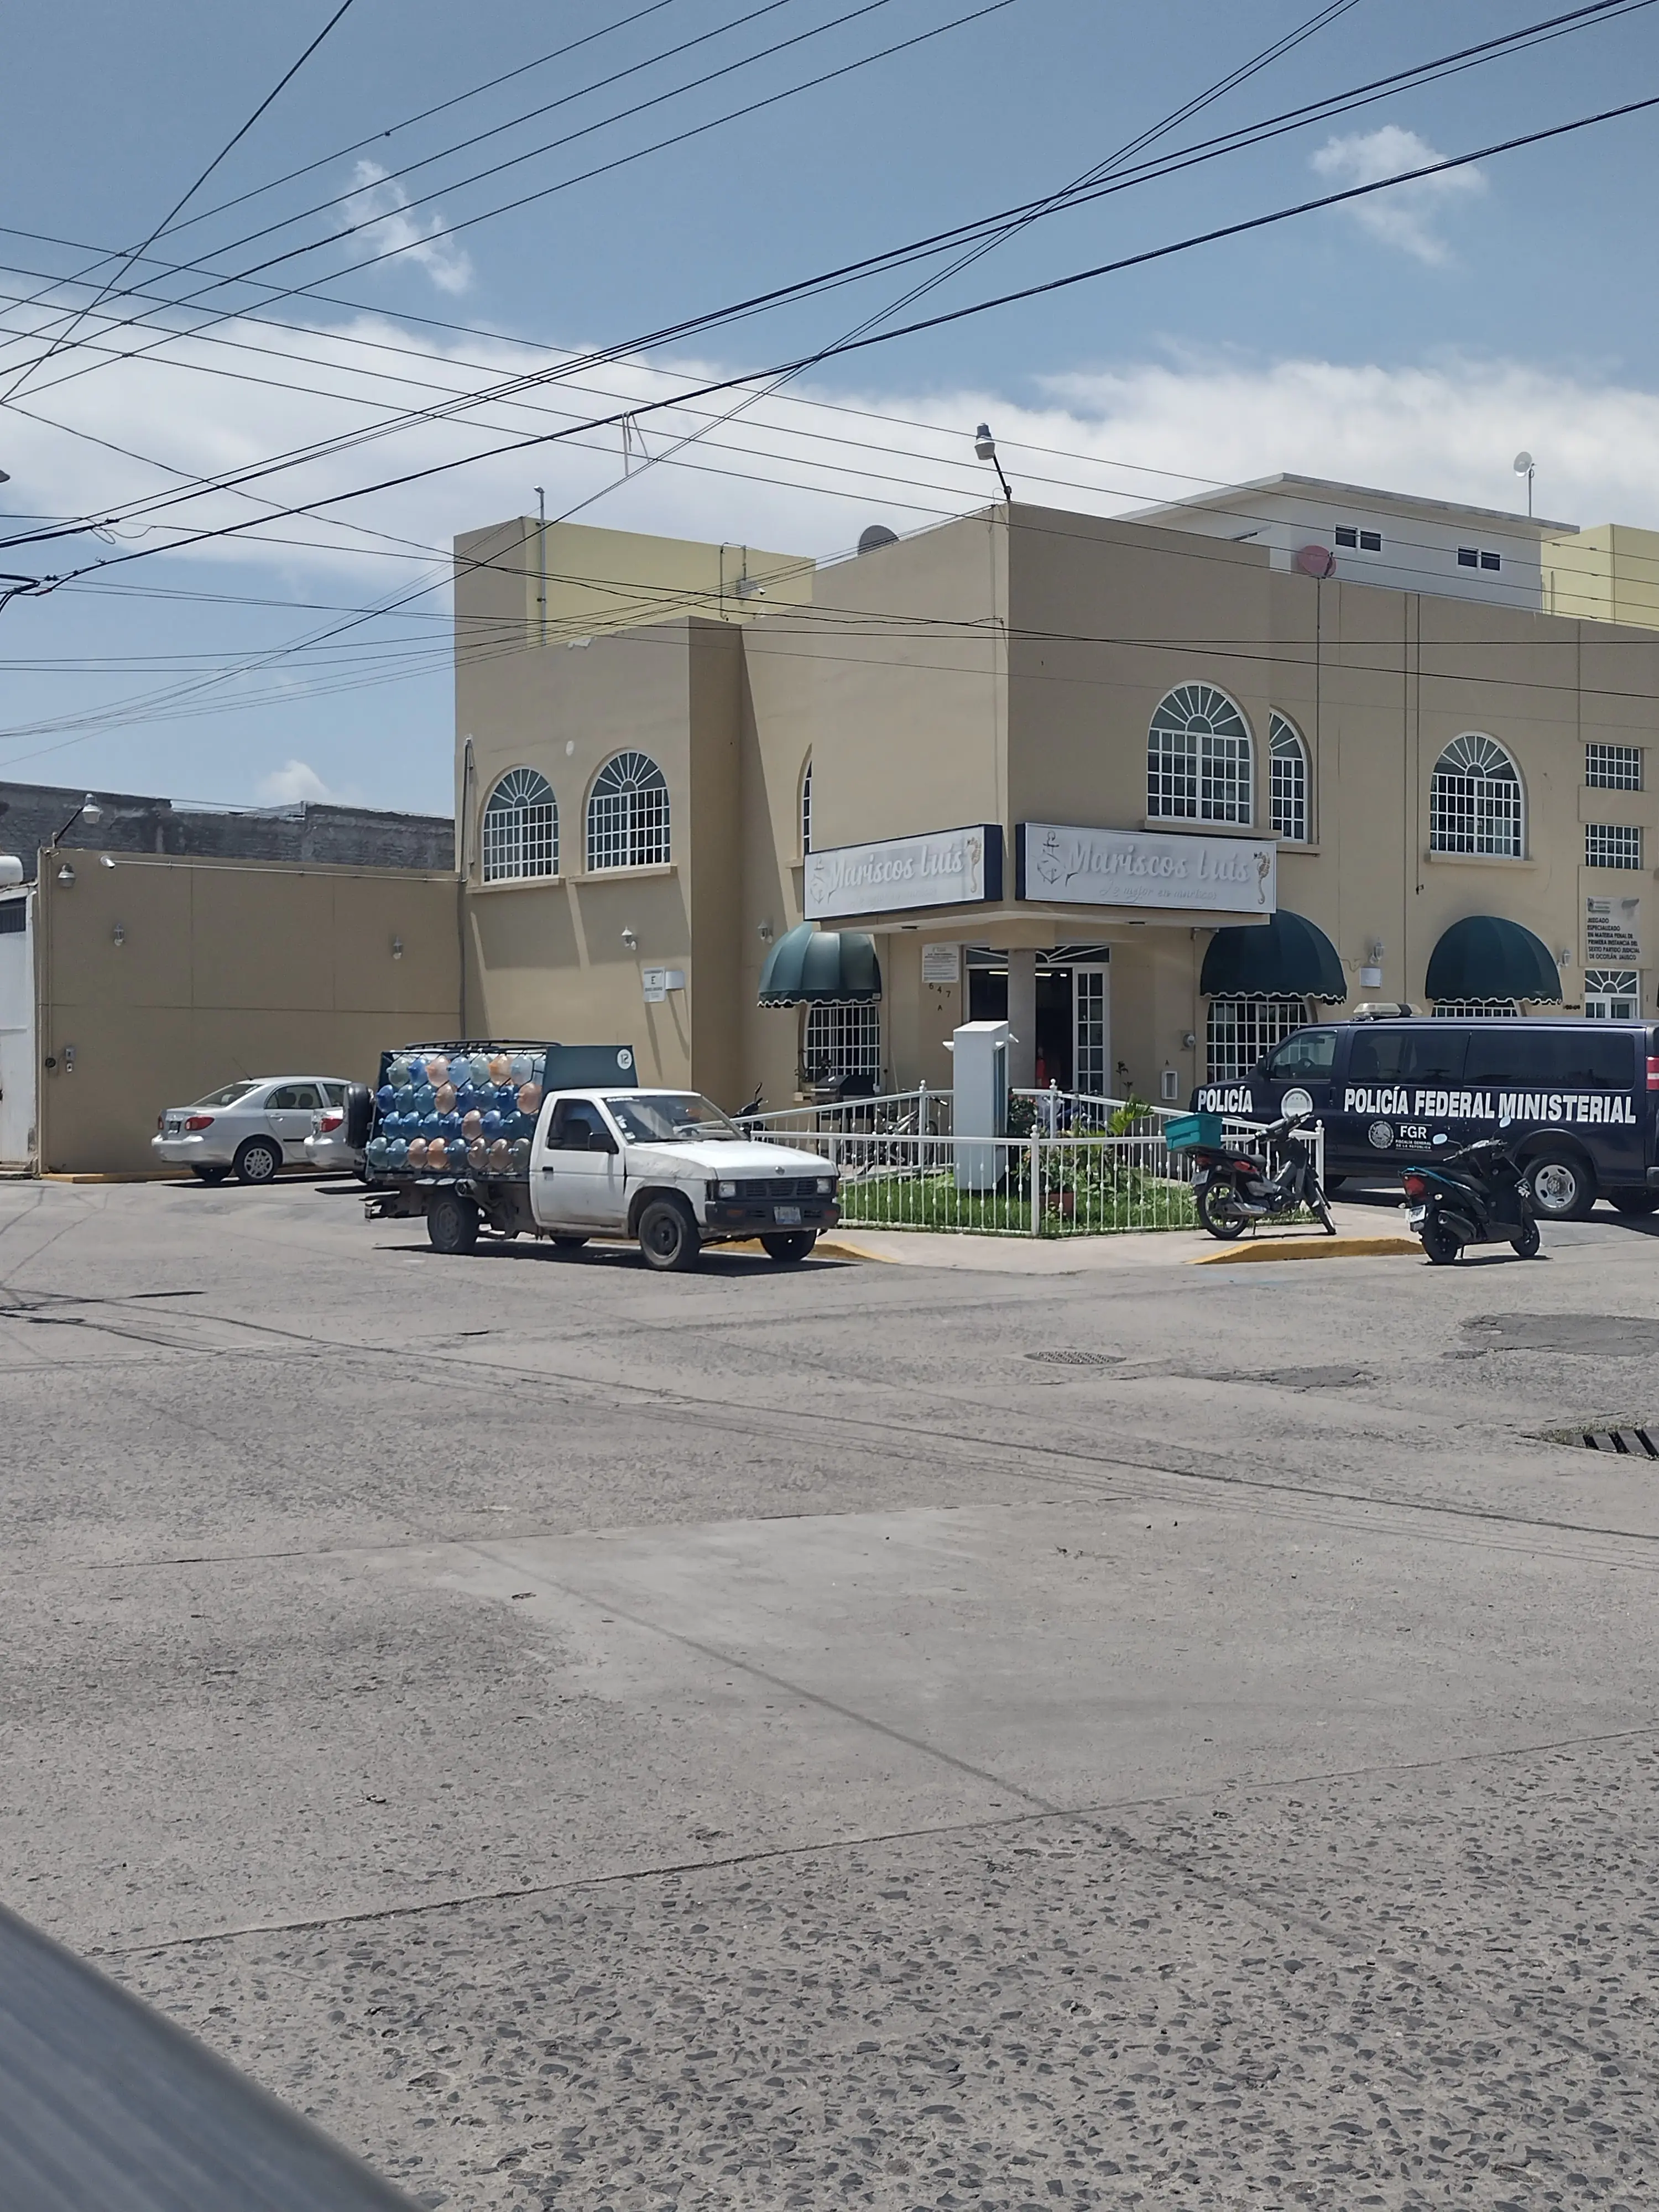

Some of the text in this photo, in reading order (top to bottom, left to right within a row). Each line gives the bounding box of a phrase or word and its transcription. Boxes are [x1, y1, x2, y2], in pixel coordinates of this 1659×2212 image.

[828, 853, 915, 893] Mariscos
[1065, 839, 1189, 883] Mariscos
[620, 1053, 629, 1064] 12
[1197, 1086, 1253, 1113] POLICÍA
[1344, 1085, 1408, 1115] POLICÍA
[1414, 1090, 1495, 1119] FEDERAL
[1498, 1092, 1636, 1124] MINISTERIAL
[1400, 1125, 1427, 1139] FGR
